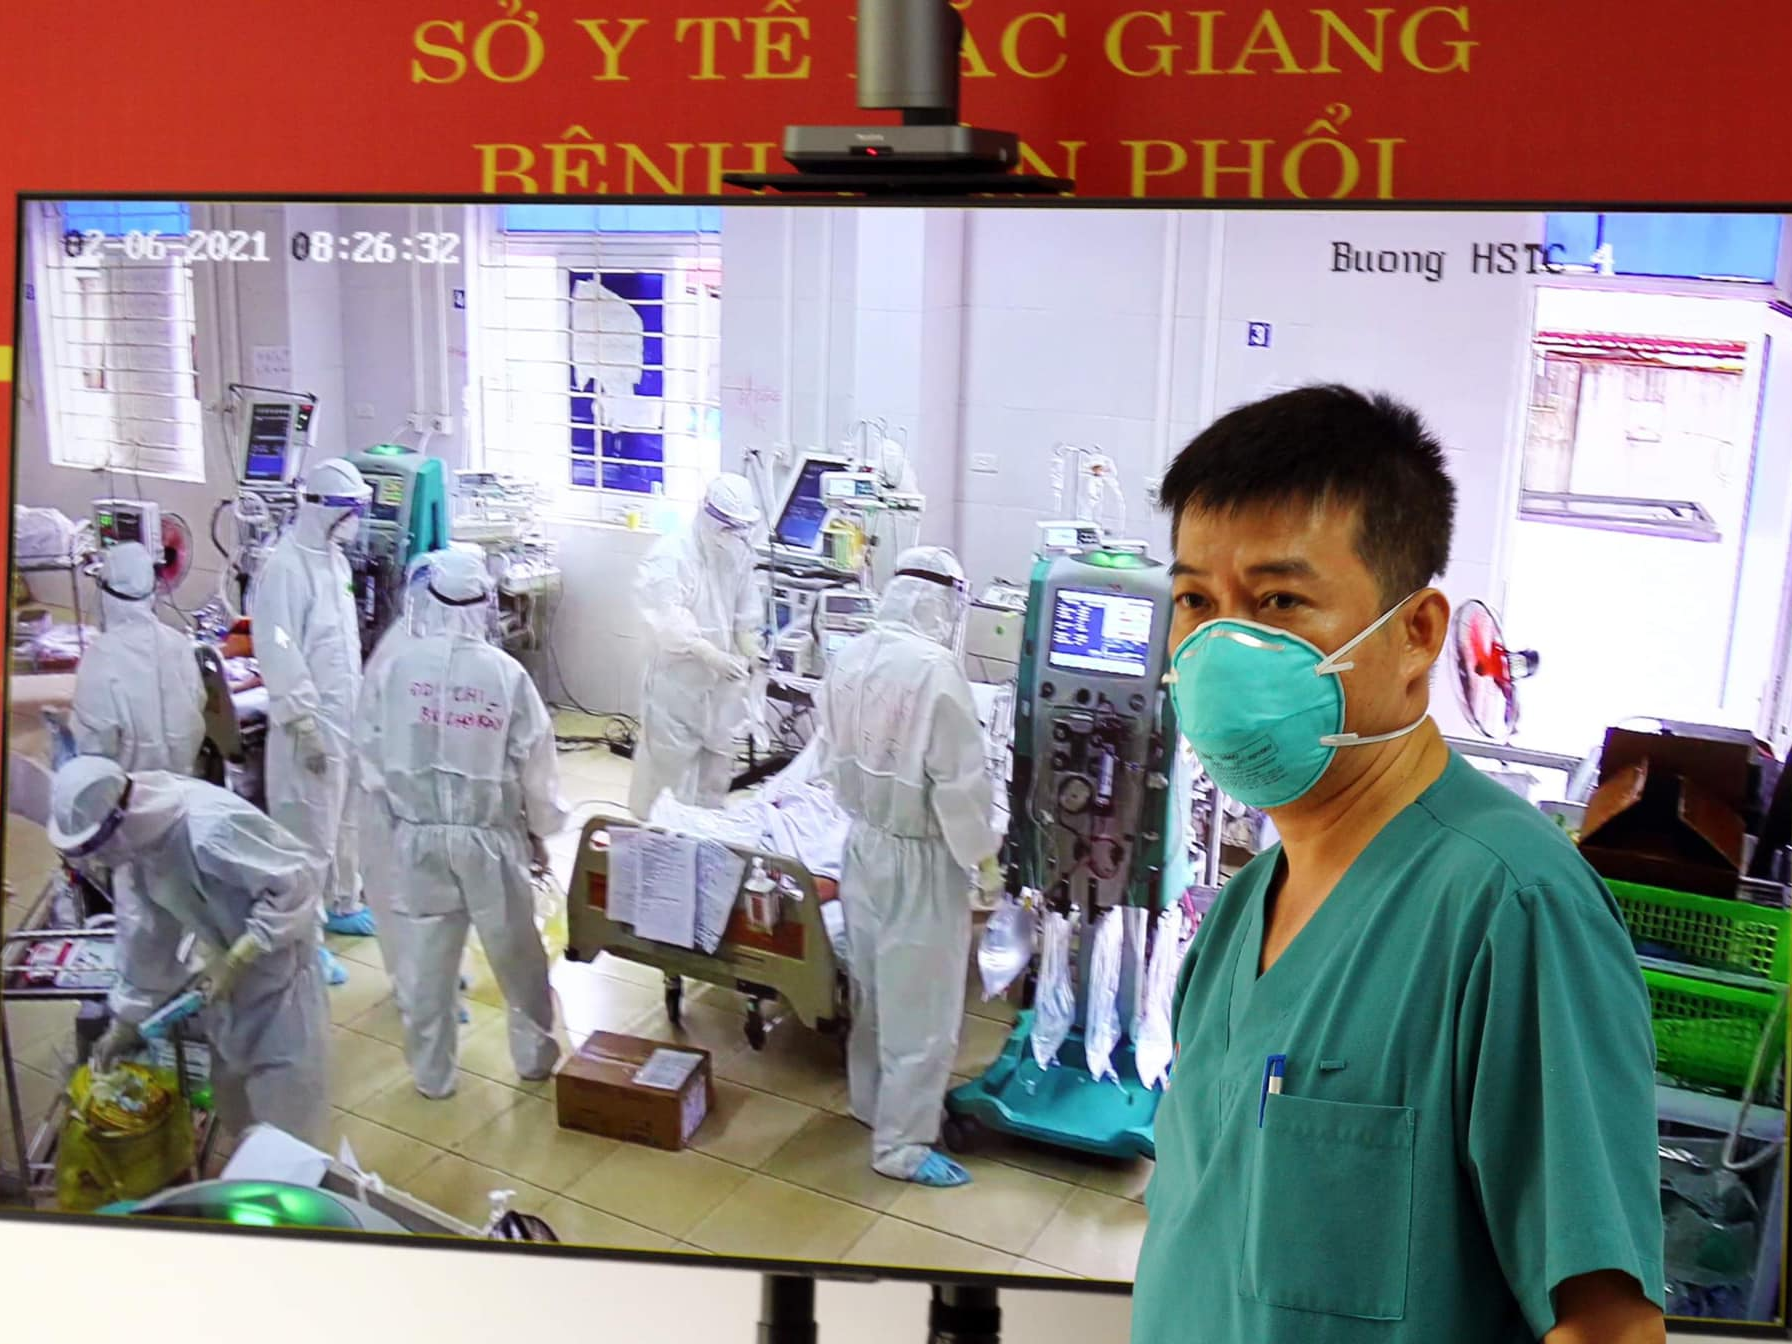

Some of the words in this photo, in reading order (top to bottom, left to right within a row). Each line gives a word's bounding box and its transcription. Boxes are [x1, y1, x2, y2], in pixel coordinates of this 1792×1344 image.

[574, 17, 649, 81] Y
[1103, 6, 1480, 77] GIANG
[1121, 103, 1406, 200] PHỔI
[63, 228, 270, 262] 02-06-2021
[292, 230, 461, 264] 08:26:32
[1331, 241, 1446, 282] Buong
[1471, 242, 1568, 275] HSTC
